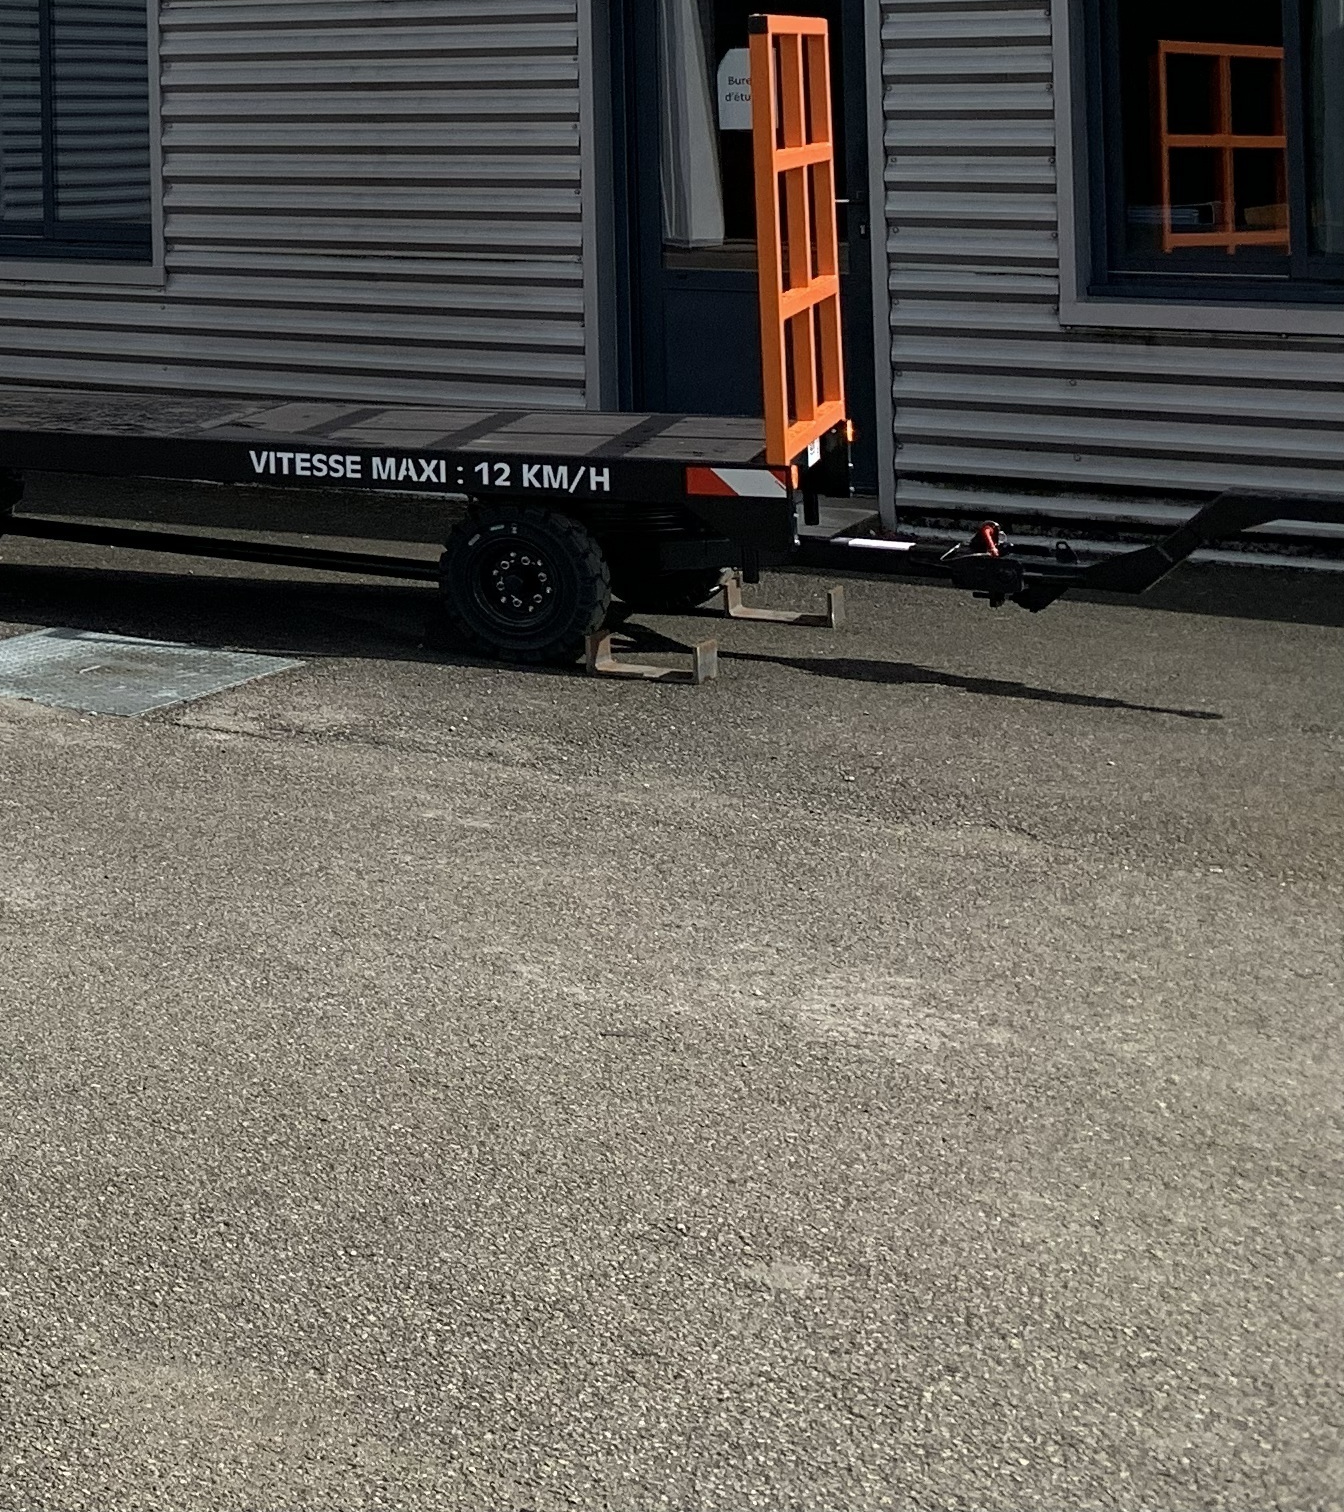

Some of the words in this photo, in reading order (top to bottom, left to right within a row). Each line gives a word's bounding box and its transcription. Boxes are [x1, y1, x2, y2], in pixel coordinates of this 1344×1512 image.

[727, 75, 752, 86] Bure
[724, 91, 752, 102] d'étu
[248, 450, 362, 479] VITESSE
[371, 456, 447, 483] MAXI
[474, 461, 511, 487] 12
[522, 463, 610, 494] KM/H
